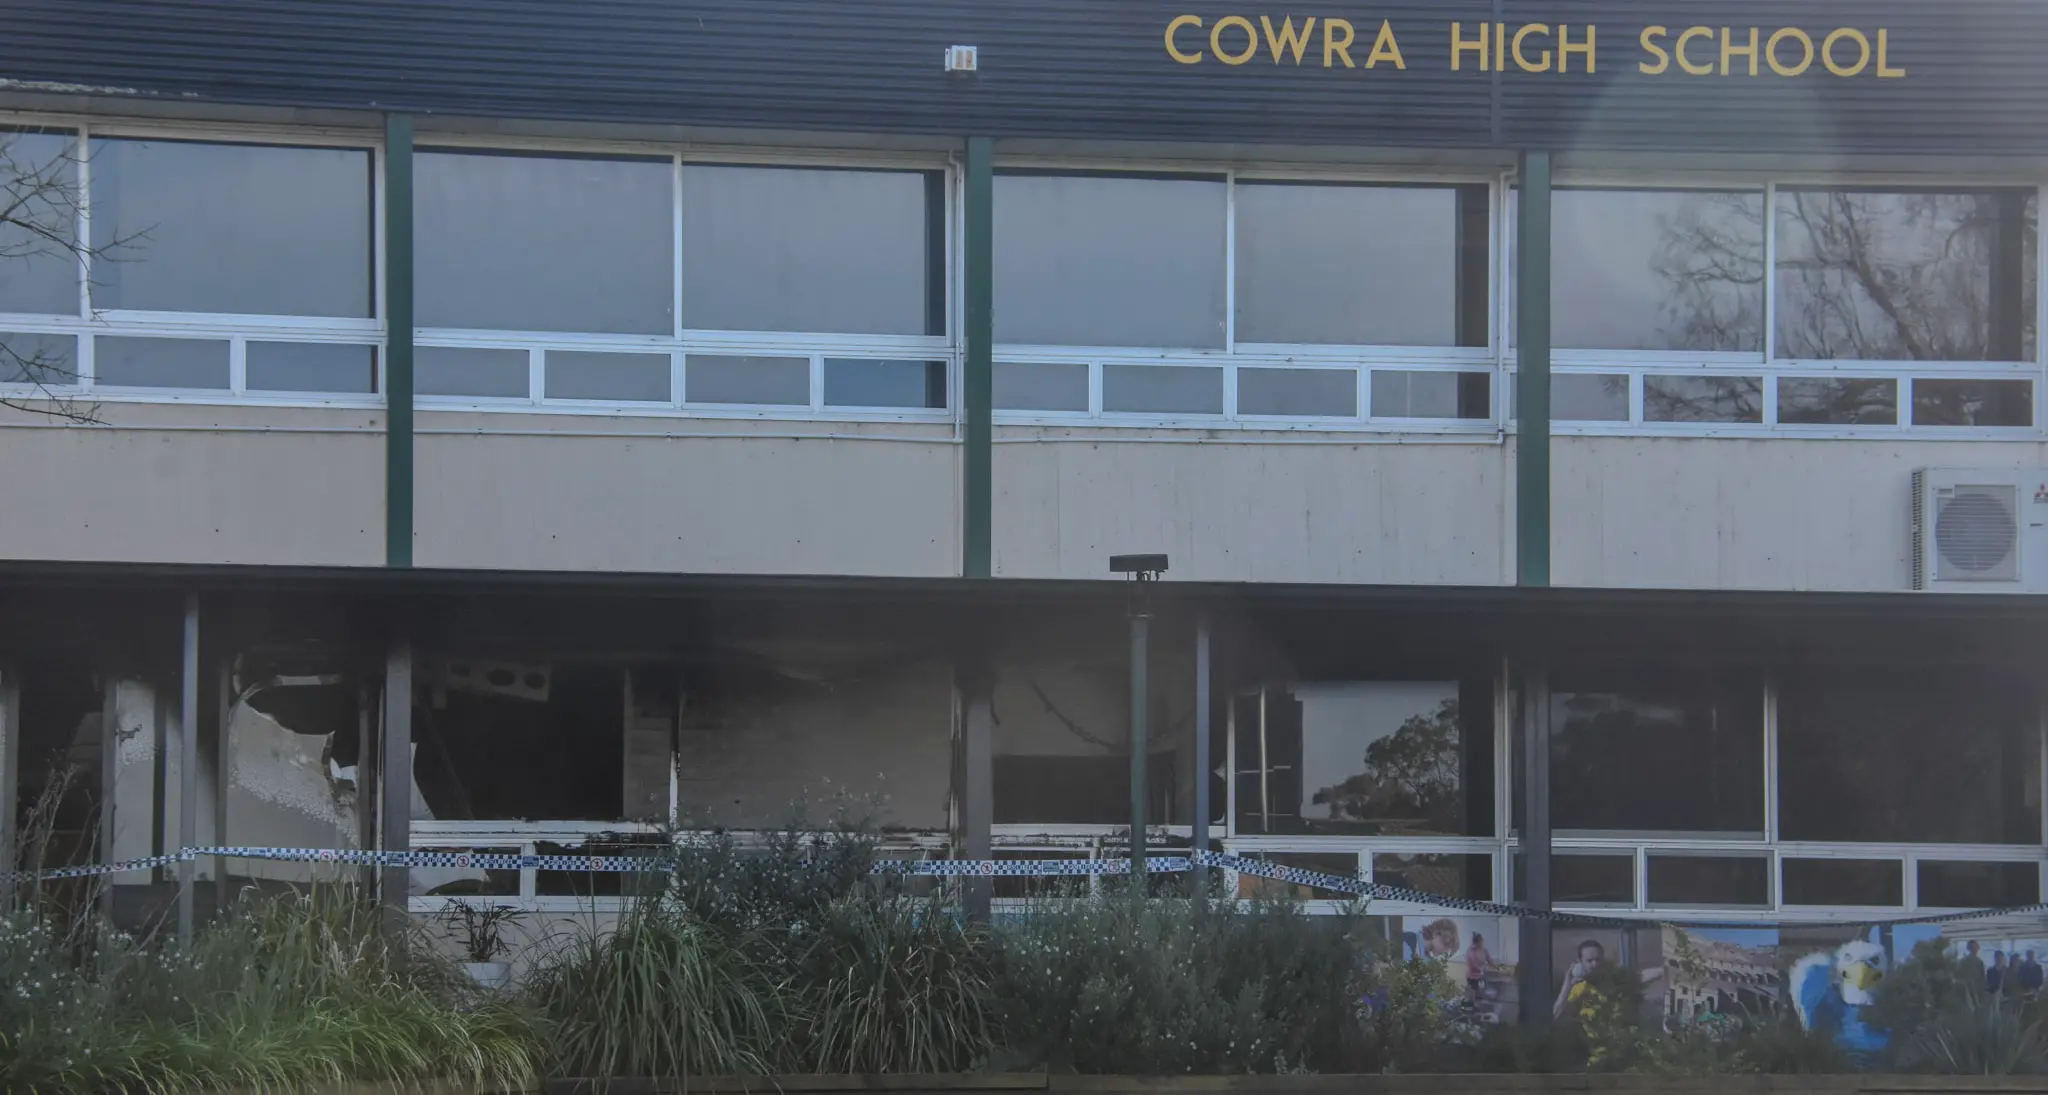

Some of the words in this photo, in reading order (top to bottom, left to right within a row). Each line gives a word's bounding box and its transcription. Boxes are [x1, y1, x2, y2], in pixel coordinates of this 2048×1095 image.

[1164, 14, 1406, 70] COWRA
[1450, 22, 1597, 74] HIGH
[1638, 26, 1906, 79] SCHOOL
